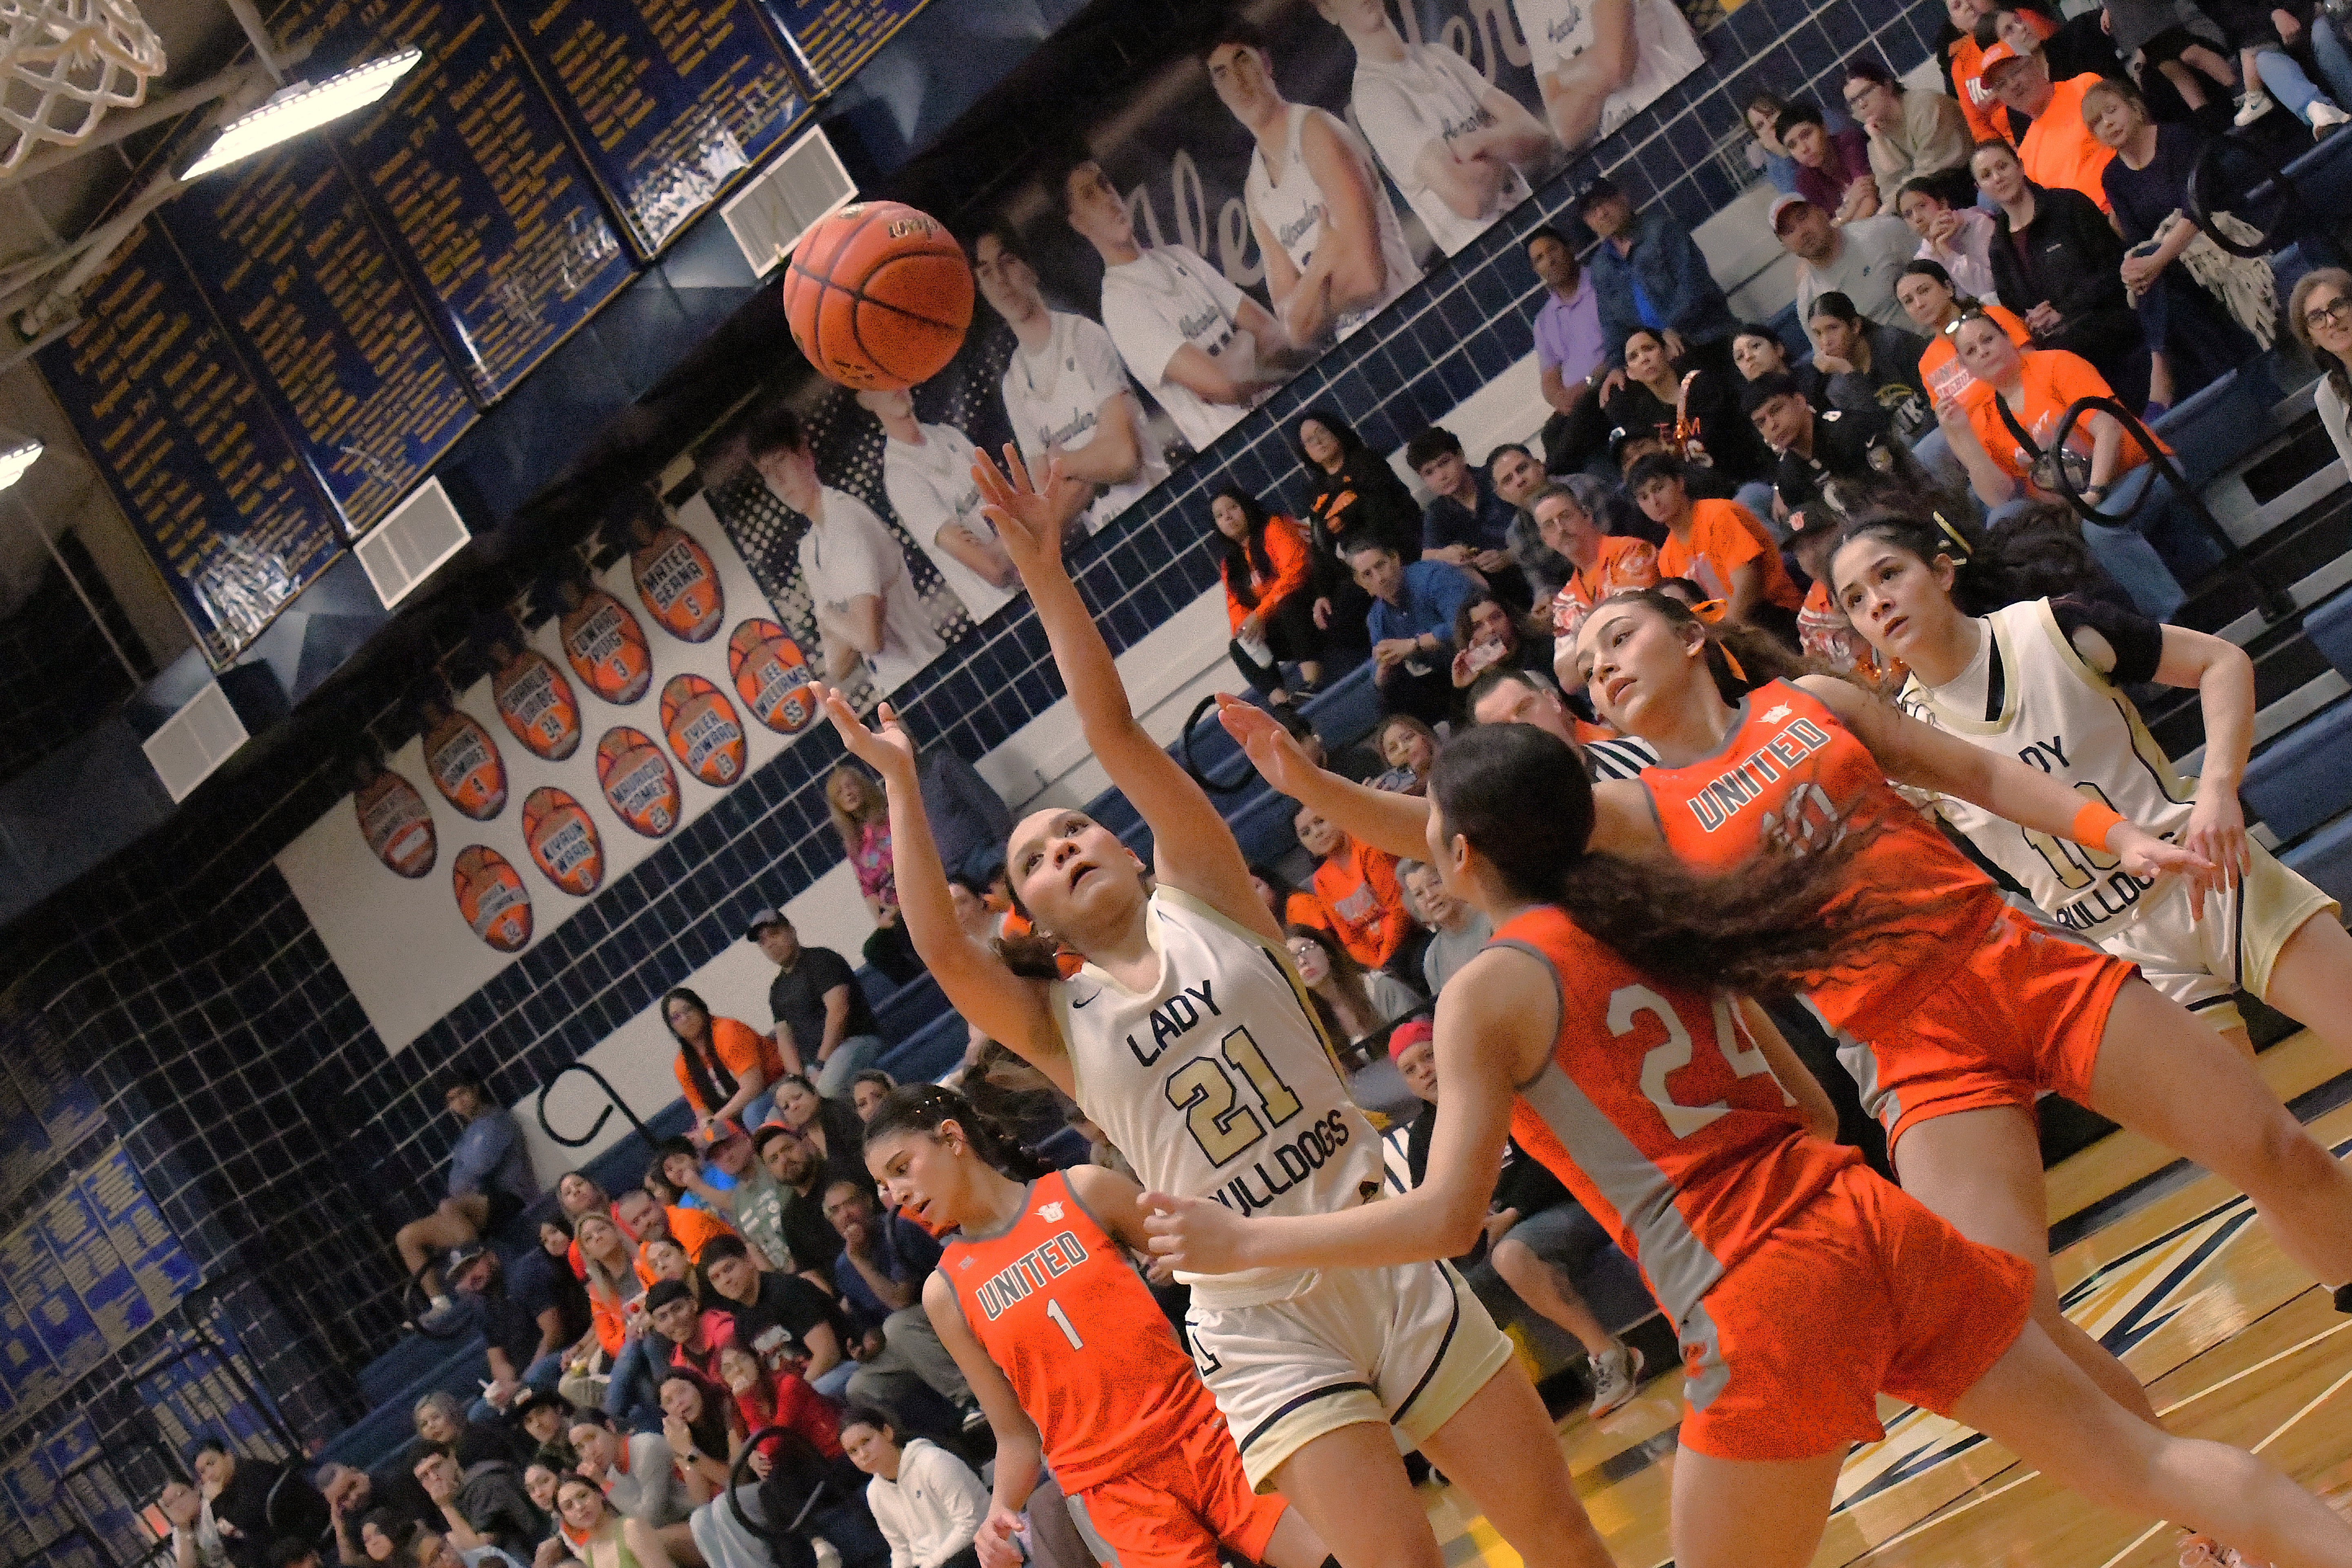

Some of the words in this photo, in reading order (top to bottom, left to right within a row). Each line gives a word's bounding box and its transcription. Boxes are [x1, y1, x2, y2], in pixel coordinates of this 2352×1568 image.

[641, 542, 693, 592] MATEO
[756, 666, 811, 716] WILLIAMS
[683, 709, 718, 743] TYLER
[688, 721, 738, 768] HOWARD
[610, 757, 666, 803] MAURICIO
[626, 778, 667, 815] GOMEZ
[1686, 717, 1831, 832] UNITED
[1127, 979, 1221, 1067] LADY
[1607, 983, 1798, 1140] 24
[1165, 1025, 1303, 1168] 21
[1208, 1110, 1349, 1217] ULLDOGS
[975, 1230, 1088, 1321] UNITED
[1047, 1298, 1084, 1352] 1
